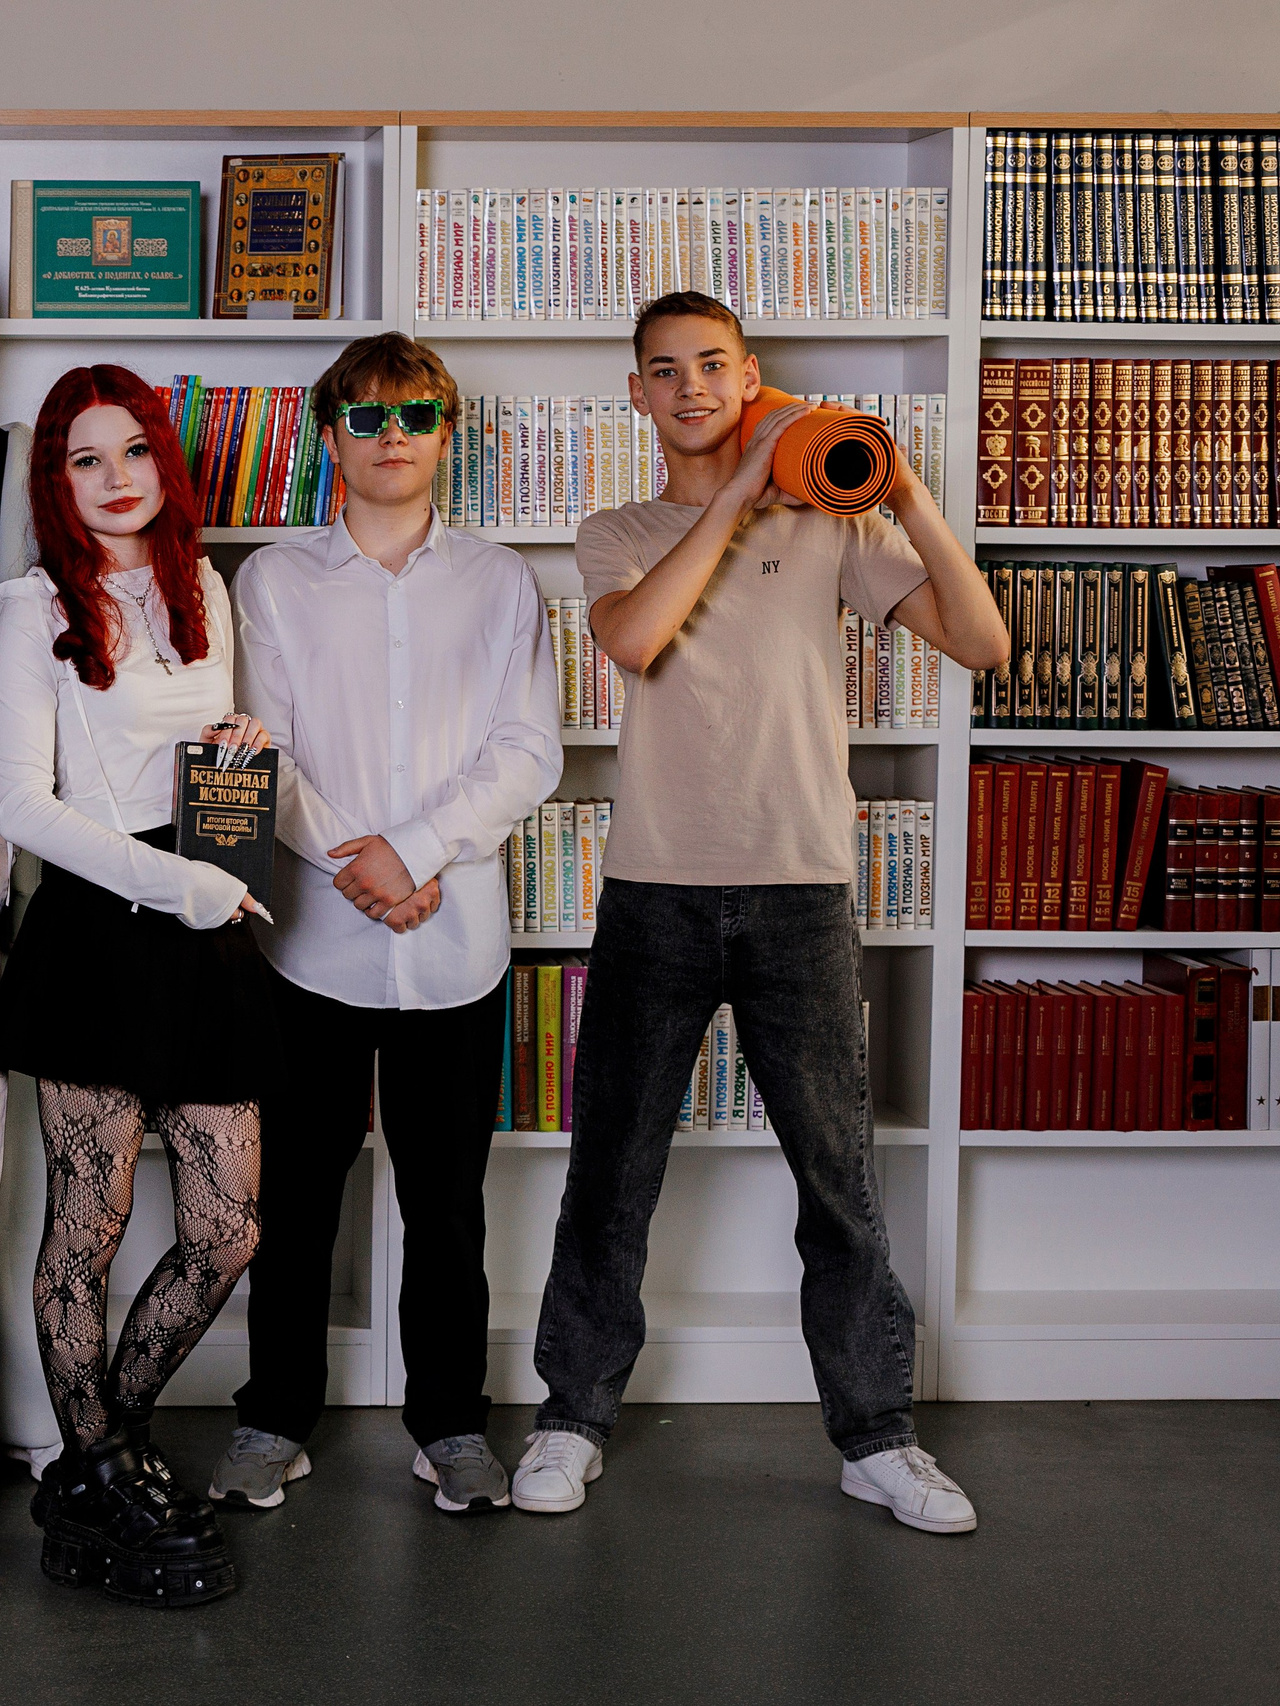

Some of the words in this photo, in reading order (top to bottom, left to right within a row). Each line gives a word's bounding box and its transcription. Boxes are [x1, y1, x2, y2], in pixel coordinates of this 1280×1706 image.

[583, 219, 593, 243] МИР
[827, 219, 837, 243] МИР
[1085, 191, 1093, 262] ЭНЦИКЛОПЕДИЯ
[1146, 193, 1155, 264] ЭНЦИКЛОПЕДИЯ
[1231, 194, 1240, 265] ЭНЦИКЛОПЕДИЯ
[453, 222, 464, 247] МИР
[793, 222, 804, 246] МИР
[453, 250, 464, 296] ПОЗНАЮ
[583, 246, 593, 294] ПОЗНАЮ
[793, 250, 804, 296] ПОЗНАЮ
[827, 246, 837, 294] ПОЗНАЮ
[992, 283, 996, 292] 1
[1011, 283, 1017, 292] 2
[1034, 284, 1039, 292] 3
[1062, 284, 1068, 293] 4
[1083, 283, 1089, 292] 5
[1104, 284, 1110, 293] 6
[1126, 285, 1132, 294] 7
[1147, 286, 1153, 294] 8
[1166, 286, 1172, 294] 9
[1185, 286, 1196, 295] 10
[1206, 286, 1215, 295] 11
[1228, 286, 1239, 295] 12
[453, 300, 464, 309] Я
[583, 297, 593, 306] Я
[793, 300, 804, 309] Я
[827, 297, 837, 305] Я
[521, 423, 530, 449] МИР
[553, 428, 564, 453] МИР
[521, 453, 530, 503] ПОЗНАЮ
[553, 455, 564, 502] ПОЗНАЮ
[521, 506, 530, 515] Я
[553, 505, 564, 513] Я
[981, 510, 1007, 518] РОССИЯ
[762, 560, 780, 574] NY
[564, 628, 576, 655] МИР
[846, 626, 857, 651] МИР
[565, 658, 577, 709] ПОЗНАЮ
[846, 656, 857, 705] ПОЗНАЮ
[565, 711, 577, 721] Я
[847, 709, 857, 717] Я
[190, 769, 269, 789] ВСЕМИРНАЯ
[199, 787, 258, 804] ИСТОРИЯ
[1003, 780, 1011, 812] ПАМЯТИ
[1030, 781, 1038, 813] ПАМЯТИ
[1104, 783, 1113, 816] ПАМЯТИ
[226, 817, 248, 825] ВТОРОЙ
[1028, 815, 1036, 840] КНИГА
[526, 835, 536, 859] МИР
[903, 831, 913, 855] МИР
[527, 862, 536, 908] ПОЗНАЮ
[902, 858, 913, 903] ПОЗНАЮ
[974, 887, 982, 897] 9
[996, 888, 1010, 898] 10
[1023, 887, 1035, 898] 11
[1046, 888, 1060, 899] 12
[1071, 887, 1085, 897] 13
[1097, 889, 1111, 900] 14
[1126, 886, 1139, 897] 15
[527, 911, 536, 920] Я
[902, 906, 912, 914] Я
[545, 1032, 555, 1055] МИР
[717, 1030, 728, 1055] МИР
[545, 1060, 555, 1110] ПОЗНАЮ
[716, 1059, 727, 1108] ПОЗНАЮ
[546, 1114, 555, 1122] Я
[715, 1111, 726, 1120] Я
